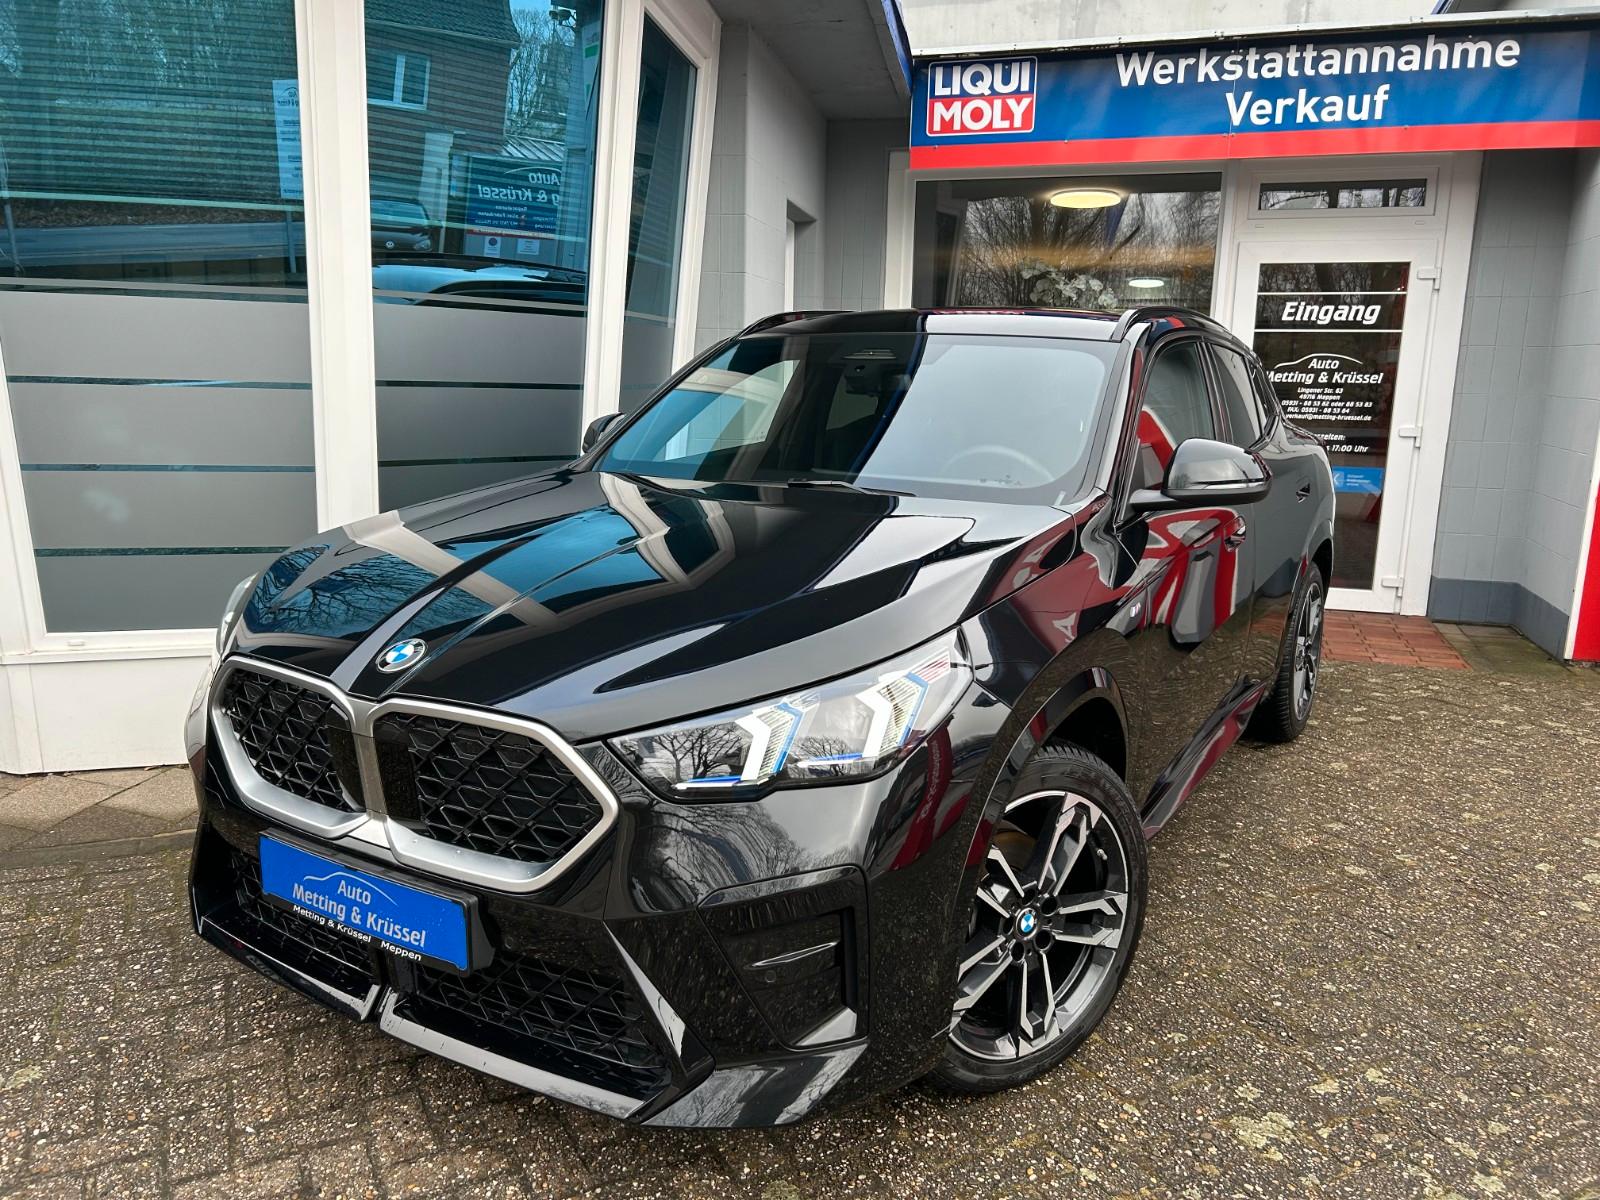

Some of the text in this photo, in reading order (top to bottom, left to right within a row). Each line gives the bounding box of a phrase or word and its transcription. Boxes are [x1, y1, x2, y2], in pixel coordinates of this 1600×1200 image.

[933, 61, 1031, 97] LIQUI
[1116, 35, 1520, 87] Werkstattannahme
[931, 96, 1033, 132] MOLY
[1225, 84, 1390, 128] Verkauf
[1281, 301, 1381, 325] Eingang
[1308, 358, 1340, 370] Auto
[1318, 371, 1328, 383] &
[1332, 371, 1384, 384] Krüssel
[337, 879, 372, 905] Auto
[292, 883, 426, 948] Metting & Krüssel
[293, 904, 422, 962] Metting & Krüssel Meppen
